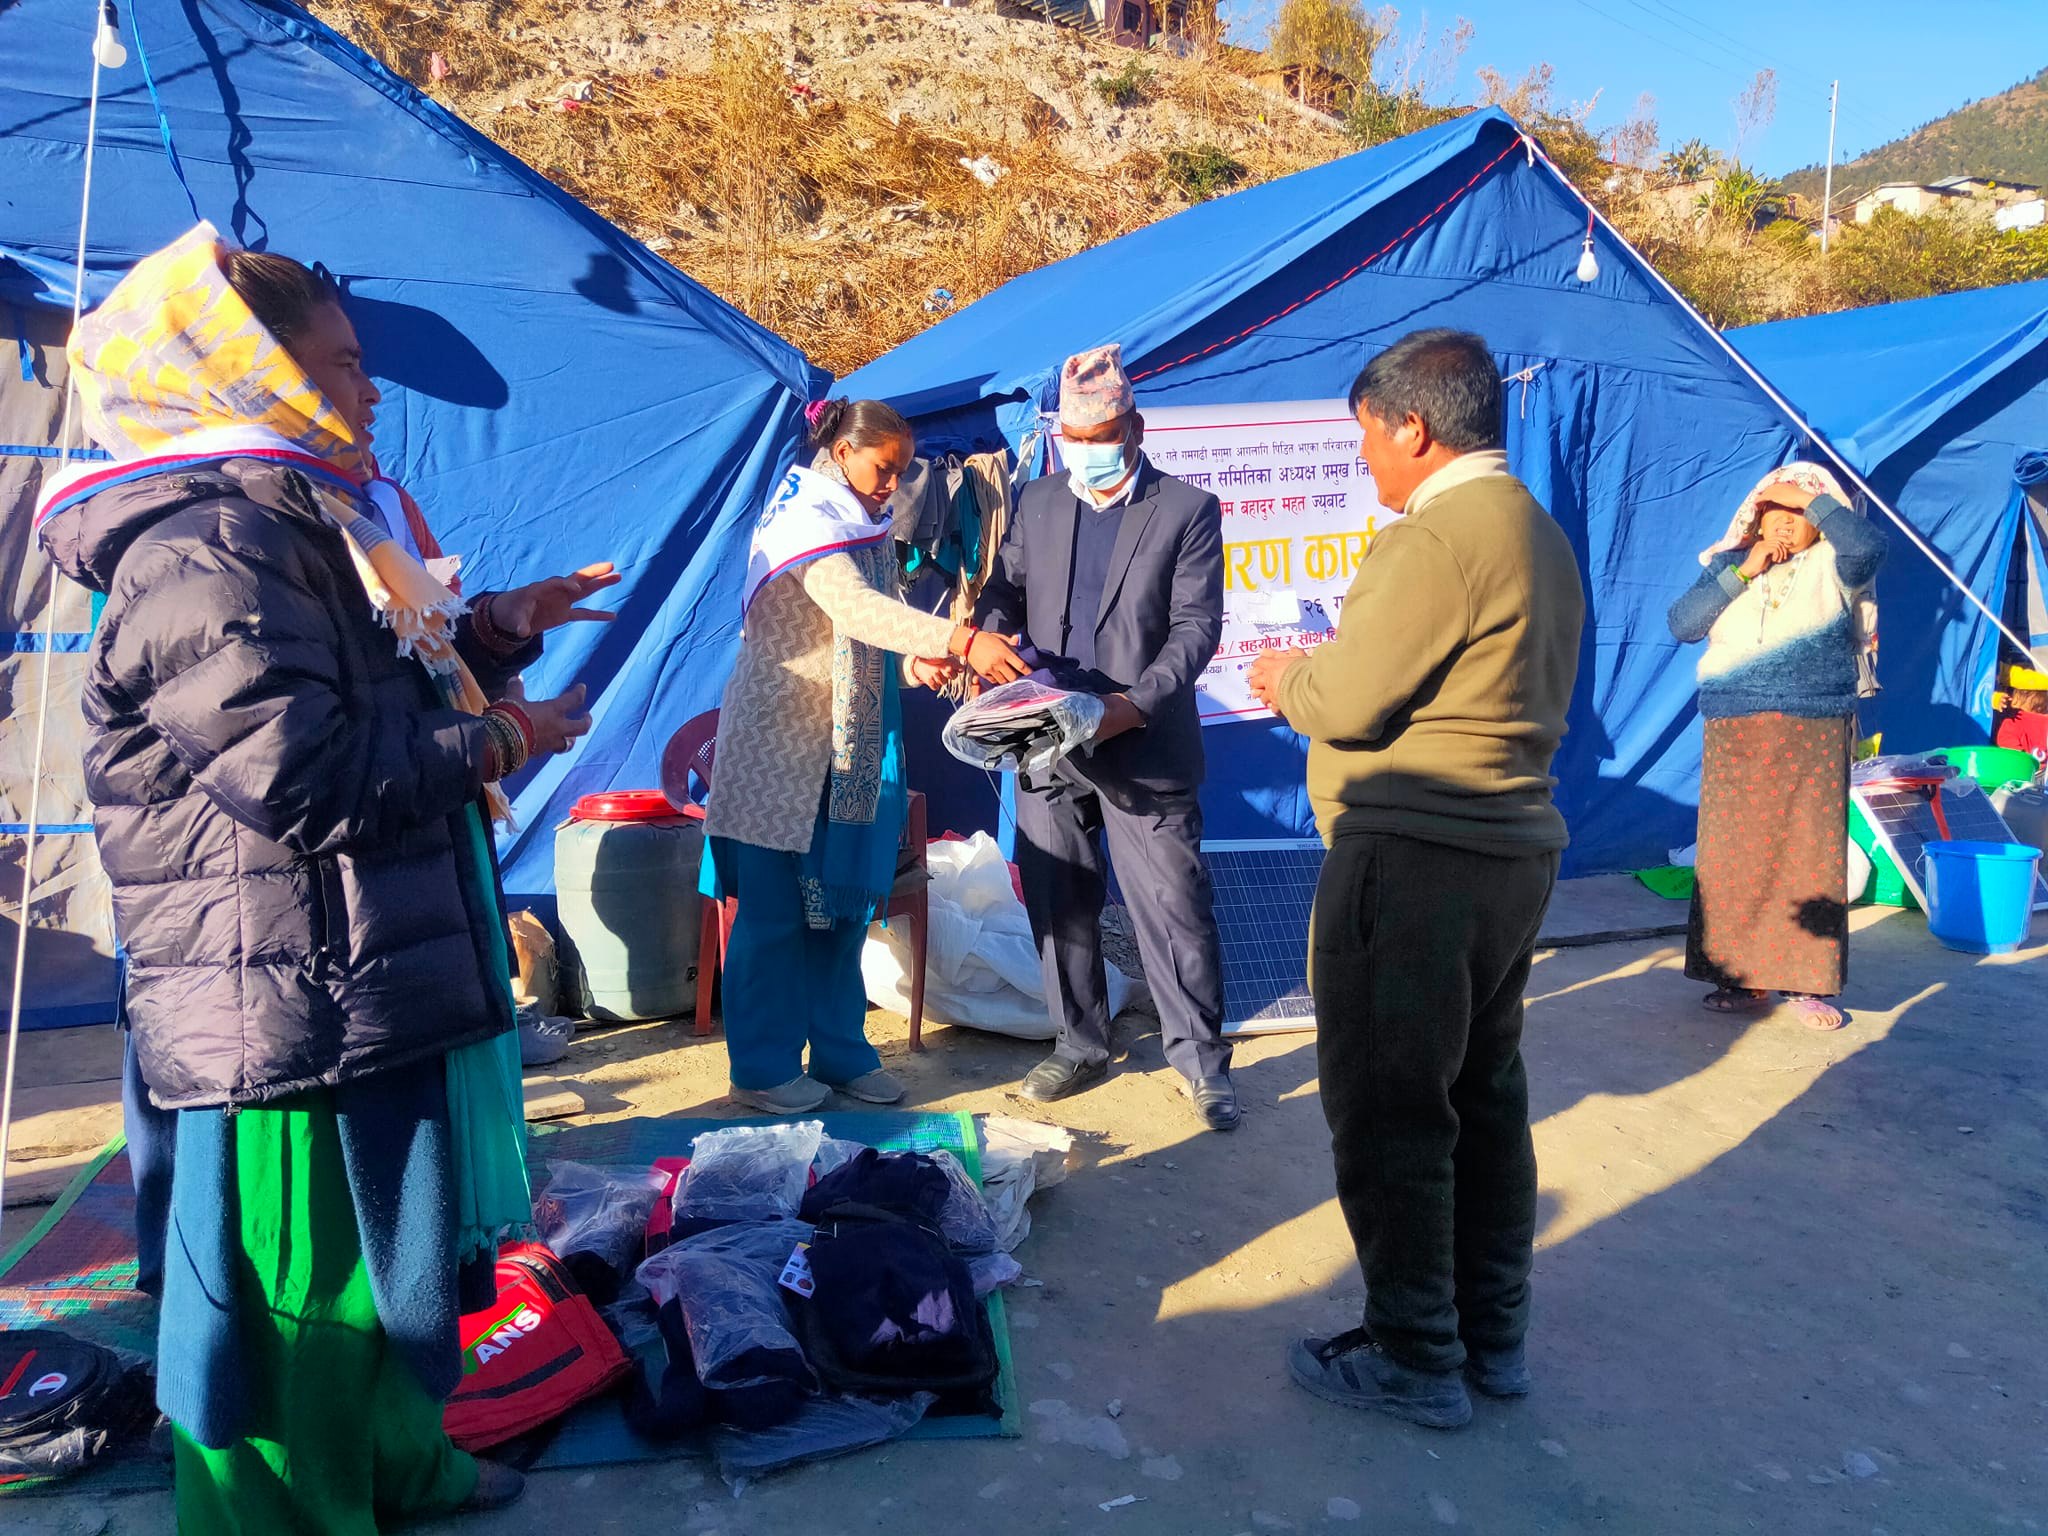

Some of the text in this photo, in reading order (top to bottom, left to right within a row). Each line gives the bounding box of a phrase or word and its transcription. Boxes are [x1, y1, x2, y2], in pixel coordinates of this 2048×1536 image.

[1166, 448, 1177, 461] गते
[1298, 442, 1318, 455] भएका
[1323, 437, 1358, 453] परिवारका
[1218, 463, 1271, 487] समितिका
[1278, 465, 1316, 482] अध्यक्ष
[1322, 463, 1349, 485] प्रमुख
[1240, 498, 1275, 521] बहादुर
[1282, 496, 1306, 515] महत
[1304, 598, 1325, 618] २६
[1239, 634, 1281, 653] सहयोग
[1286, 636, 1293, 647] र
[1299, 632, 1323, 646] साथ
